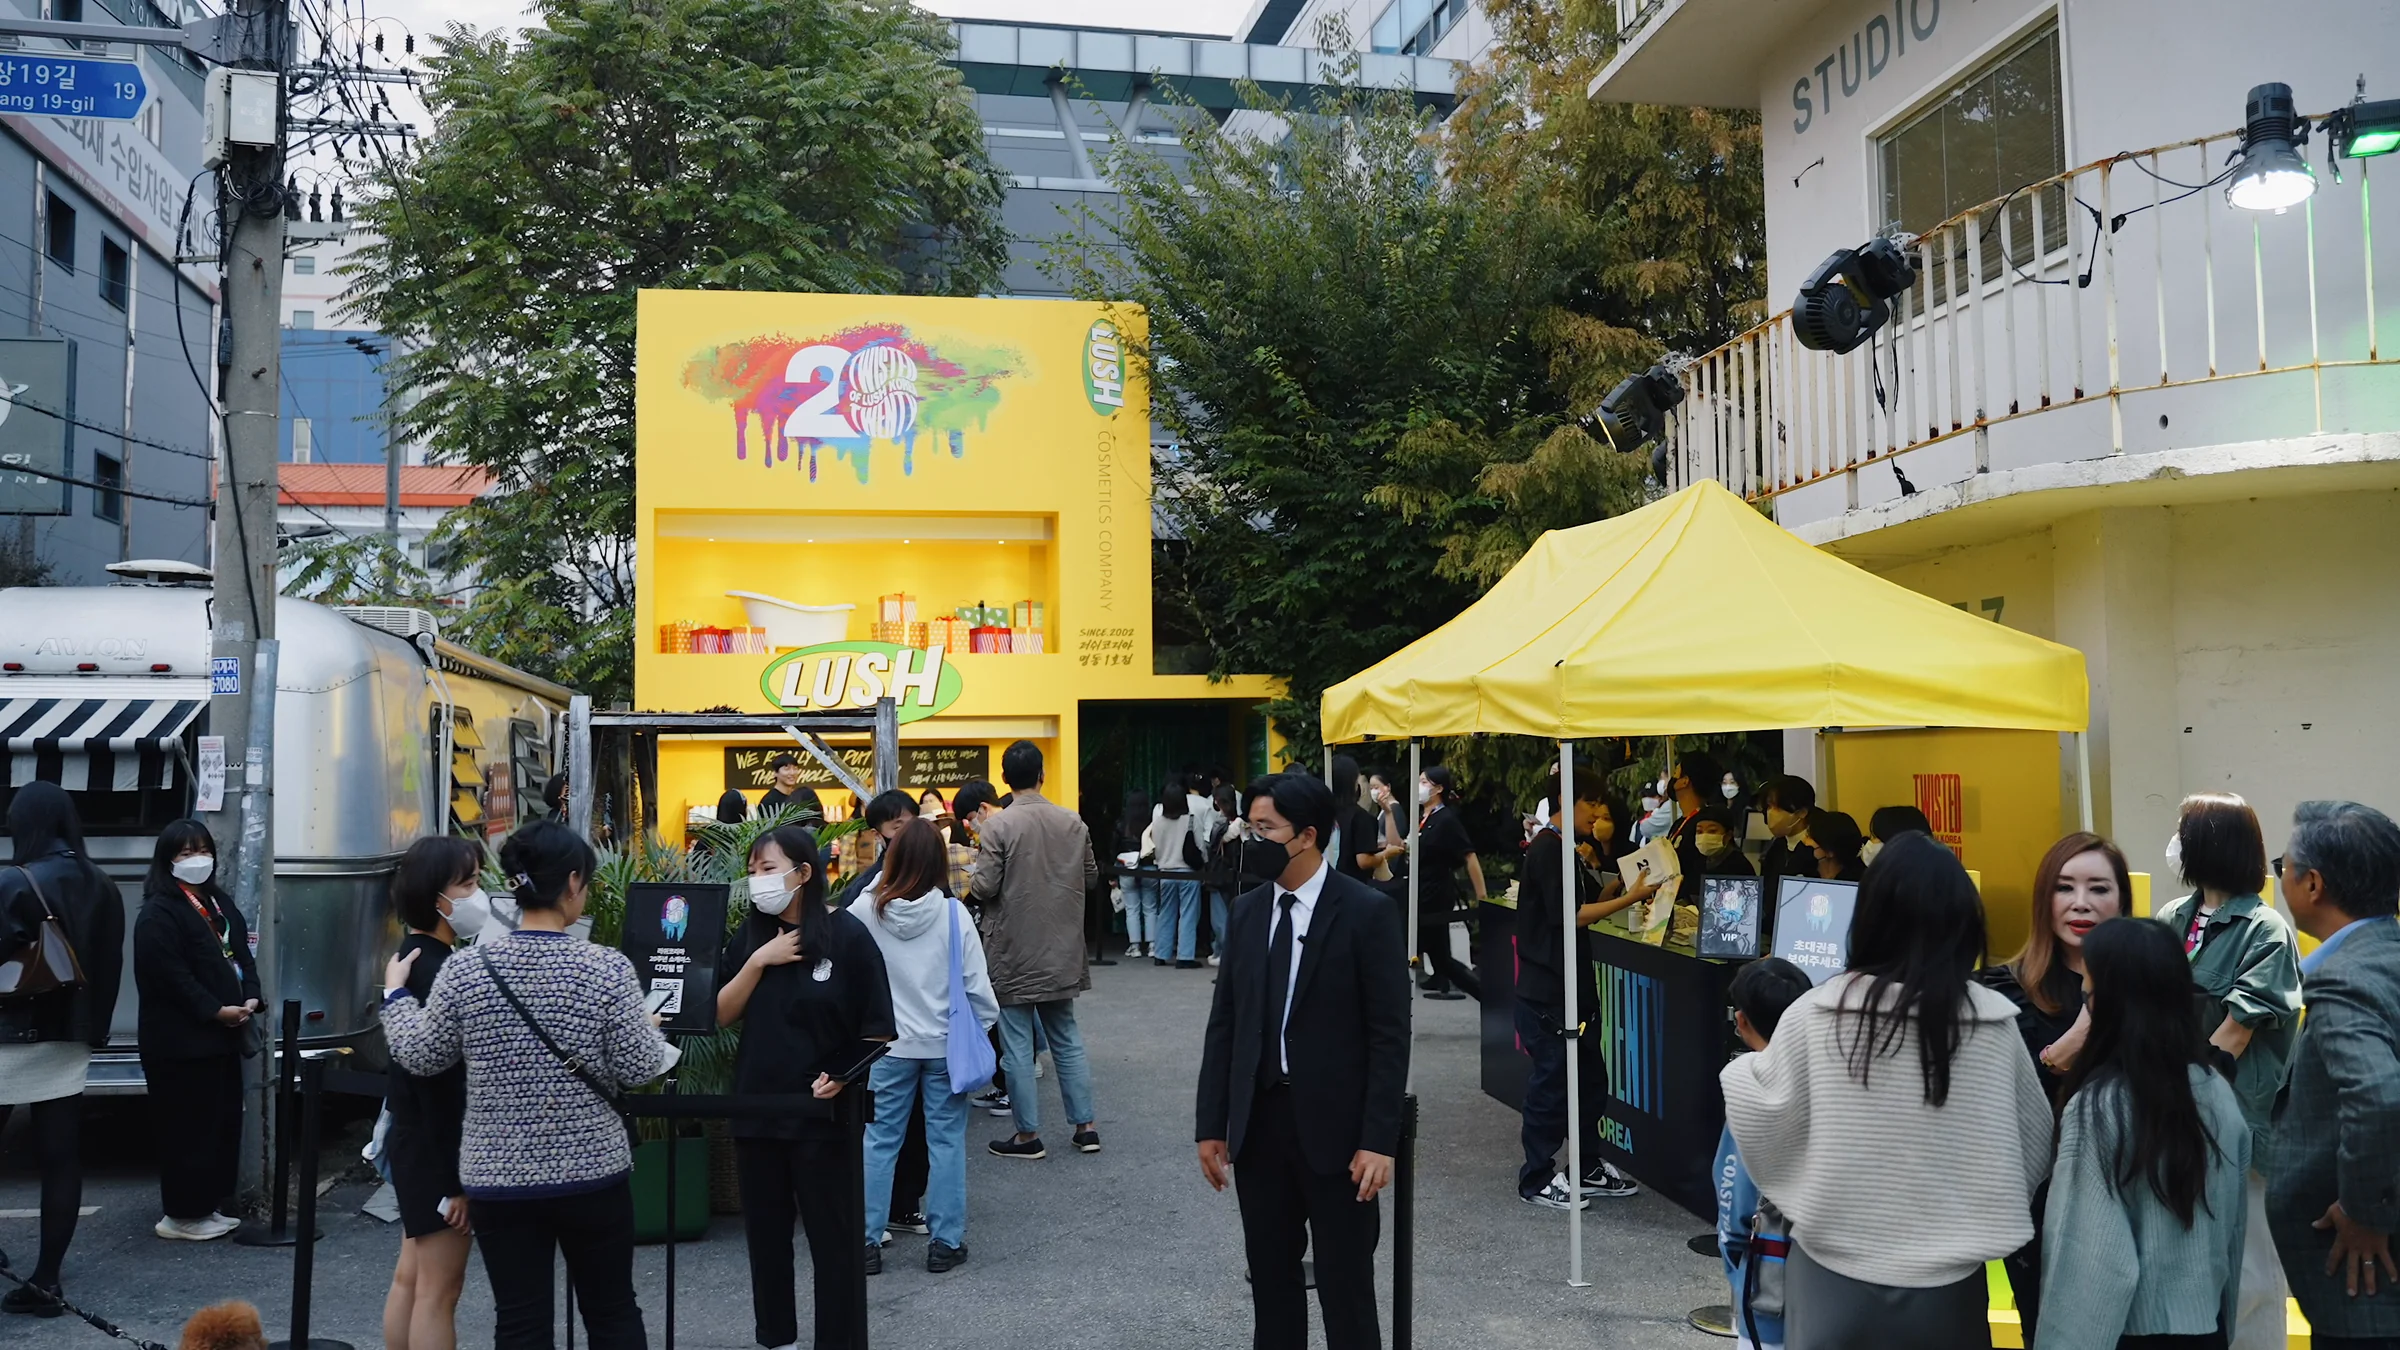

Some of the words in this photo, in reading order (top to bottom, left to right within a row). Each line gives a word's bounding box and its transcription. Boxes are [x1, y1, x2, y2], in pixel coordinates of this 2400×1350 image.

[1793, 0, 1940, 135] STUDIO
[114, 82, 137, 100] 19
[42, 93, 95, 114] 19-gil
[849, 346, 918, 394] TWISTED
[1091, 326, 1125, 408] LUSH
[862, 384, 887, 406] LUSH
[849, 391, 917, 438] TWENTY
[1097, 430, 1112, 525] COSMETICS
[1098, 530, 1113, 613] COMPANY
[34, 637, 148, 656] AVION
[1079, 639, 1135, 651] 러쉬코리아
[780, 644, 945, 708] LUSH
[735, 751, 759, 769] WE
[796, 767, 833, 783] HOLE
[1913, 773, 1962, 834] TWISTED
[1721, 933, 1738, 942] VIP
[1793, 940, 1838, 956] 초대권을
[1787, 953, 1842, 969] 보여주세요
[1719, 1153, 1738, 1211] COAST
